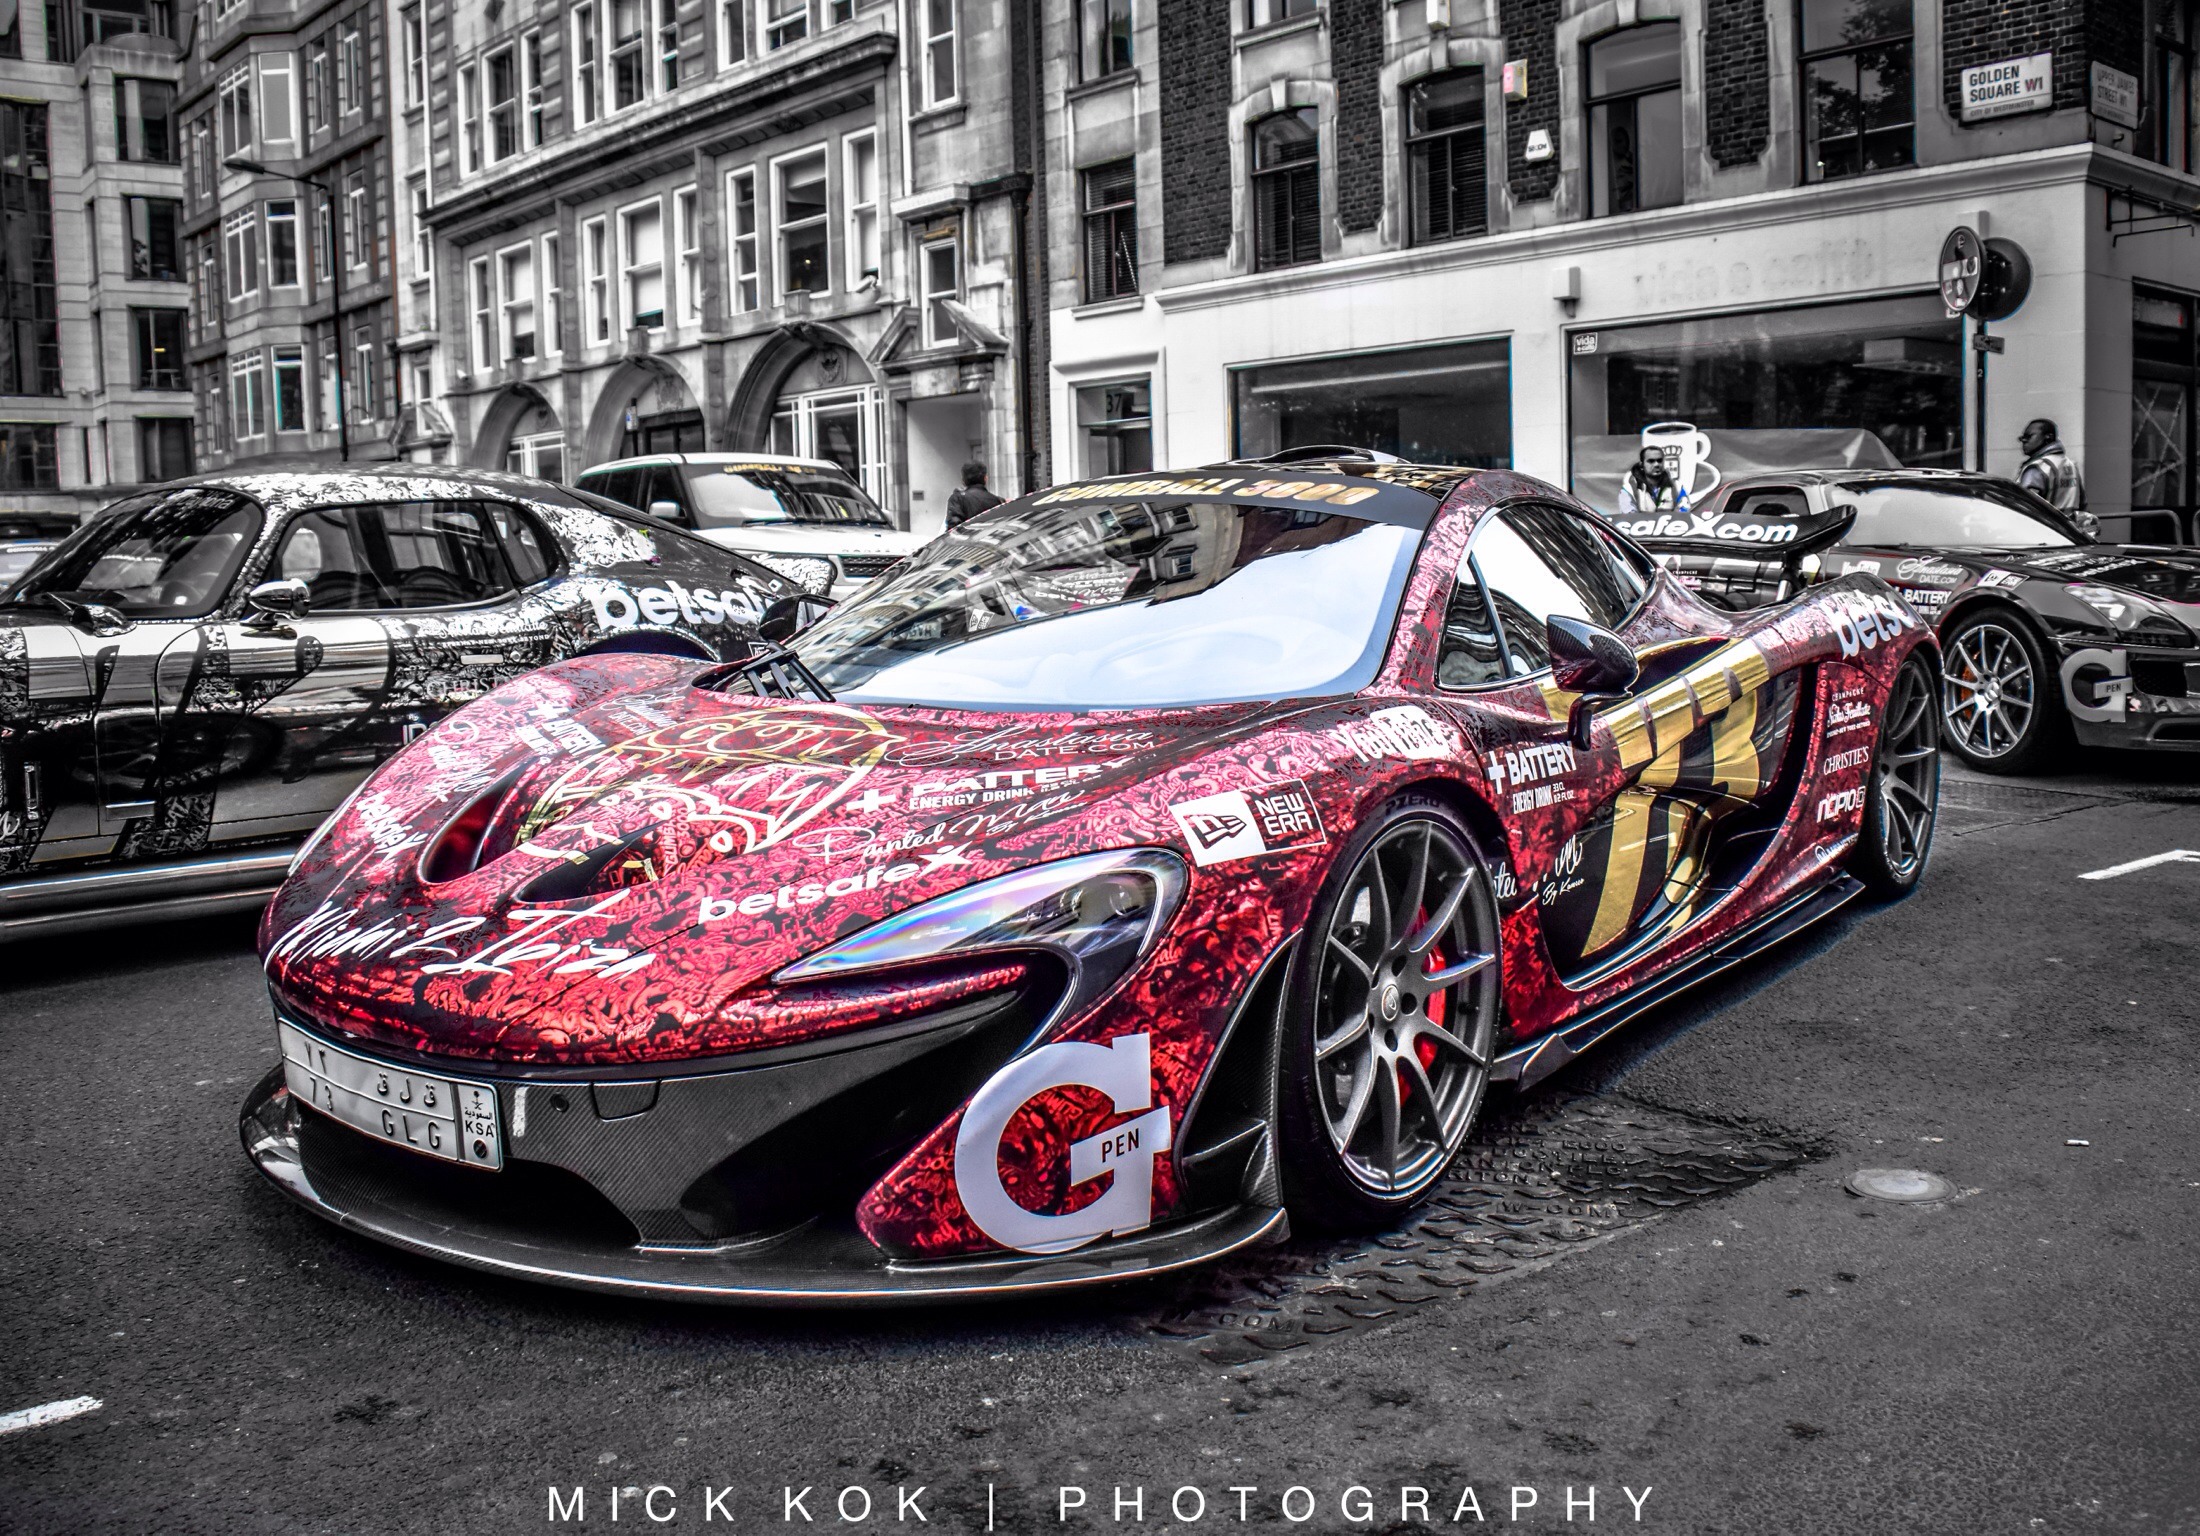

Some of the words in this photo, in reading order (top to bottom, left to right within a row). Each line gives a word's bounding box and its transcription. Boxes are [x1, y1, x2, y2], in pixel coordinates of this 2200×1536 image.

[1969, 65, 2020, 87] GOLDEN
[1970, 80, 2021, 103] SQUARE
[2025, 76, 2044, 92] W1
[1970, 108, 1983, 117] CITY
[1984, 106, 1992, 115] OF
[1993, 99, 2035, 113] WESTMINSTER
[1576, 335, 1595, 346] vida
[1106, 394, 1122, 413] 37
[1032, 478, 1246, 506] GUMBALL
[1232, 479, 1380, 506] 3000
[1919, 574, 1958, 584] DATE.COM
[1903, 588, 1952, 605] BATTERY
[2106, 682, 2122, 693] PEN
[884, 724, 1154, 767] Anastasia
[1329, 706, 1450, 762] YouTube
[994, 741, 1156, 761] DATE.COM
[1823, 746, 1870, 776] CHRISTIE'S
[1505, 741, 1578, 786] BATTERY
[909, 792, 977, 810] ENERGY
[982, 787, 1035, 803] DRINK
[1255, 793, 1306, 817] NEW
[1512, 788, 1534, 815] ENERGY
[1535, 785, 1553, 809] DRINK
[1263, 811, 1314, 836] ERA
[309, 1076, 334, 1112] 73
[464, 1106, 493, 1121] السعودية
[465, 1119, 494, 1138] KSA
[1101, 1128, 1140, 1164] PEN
